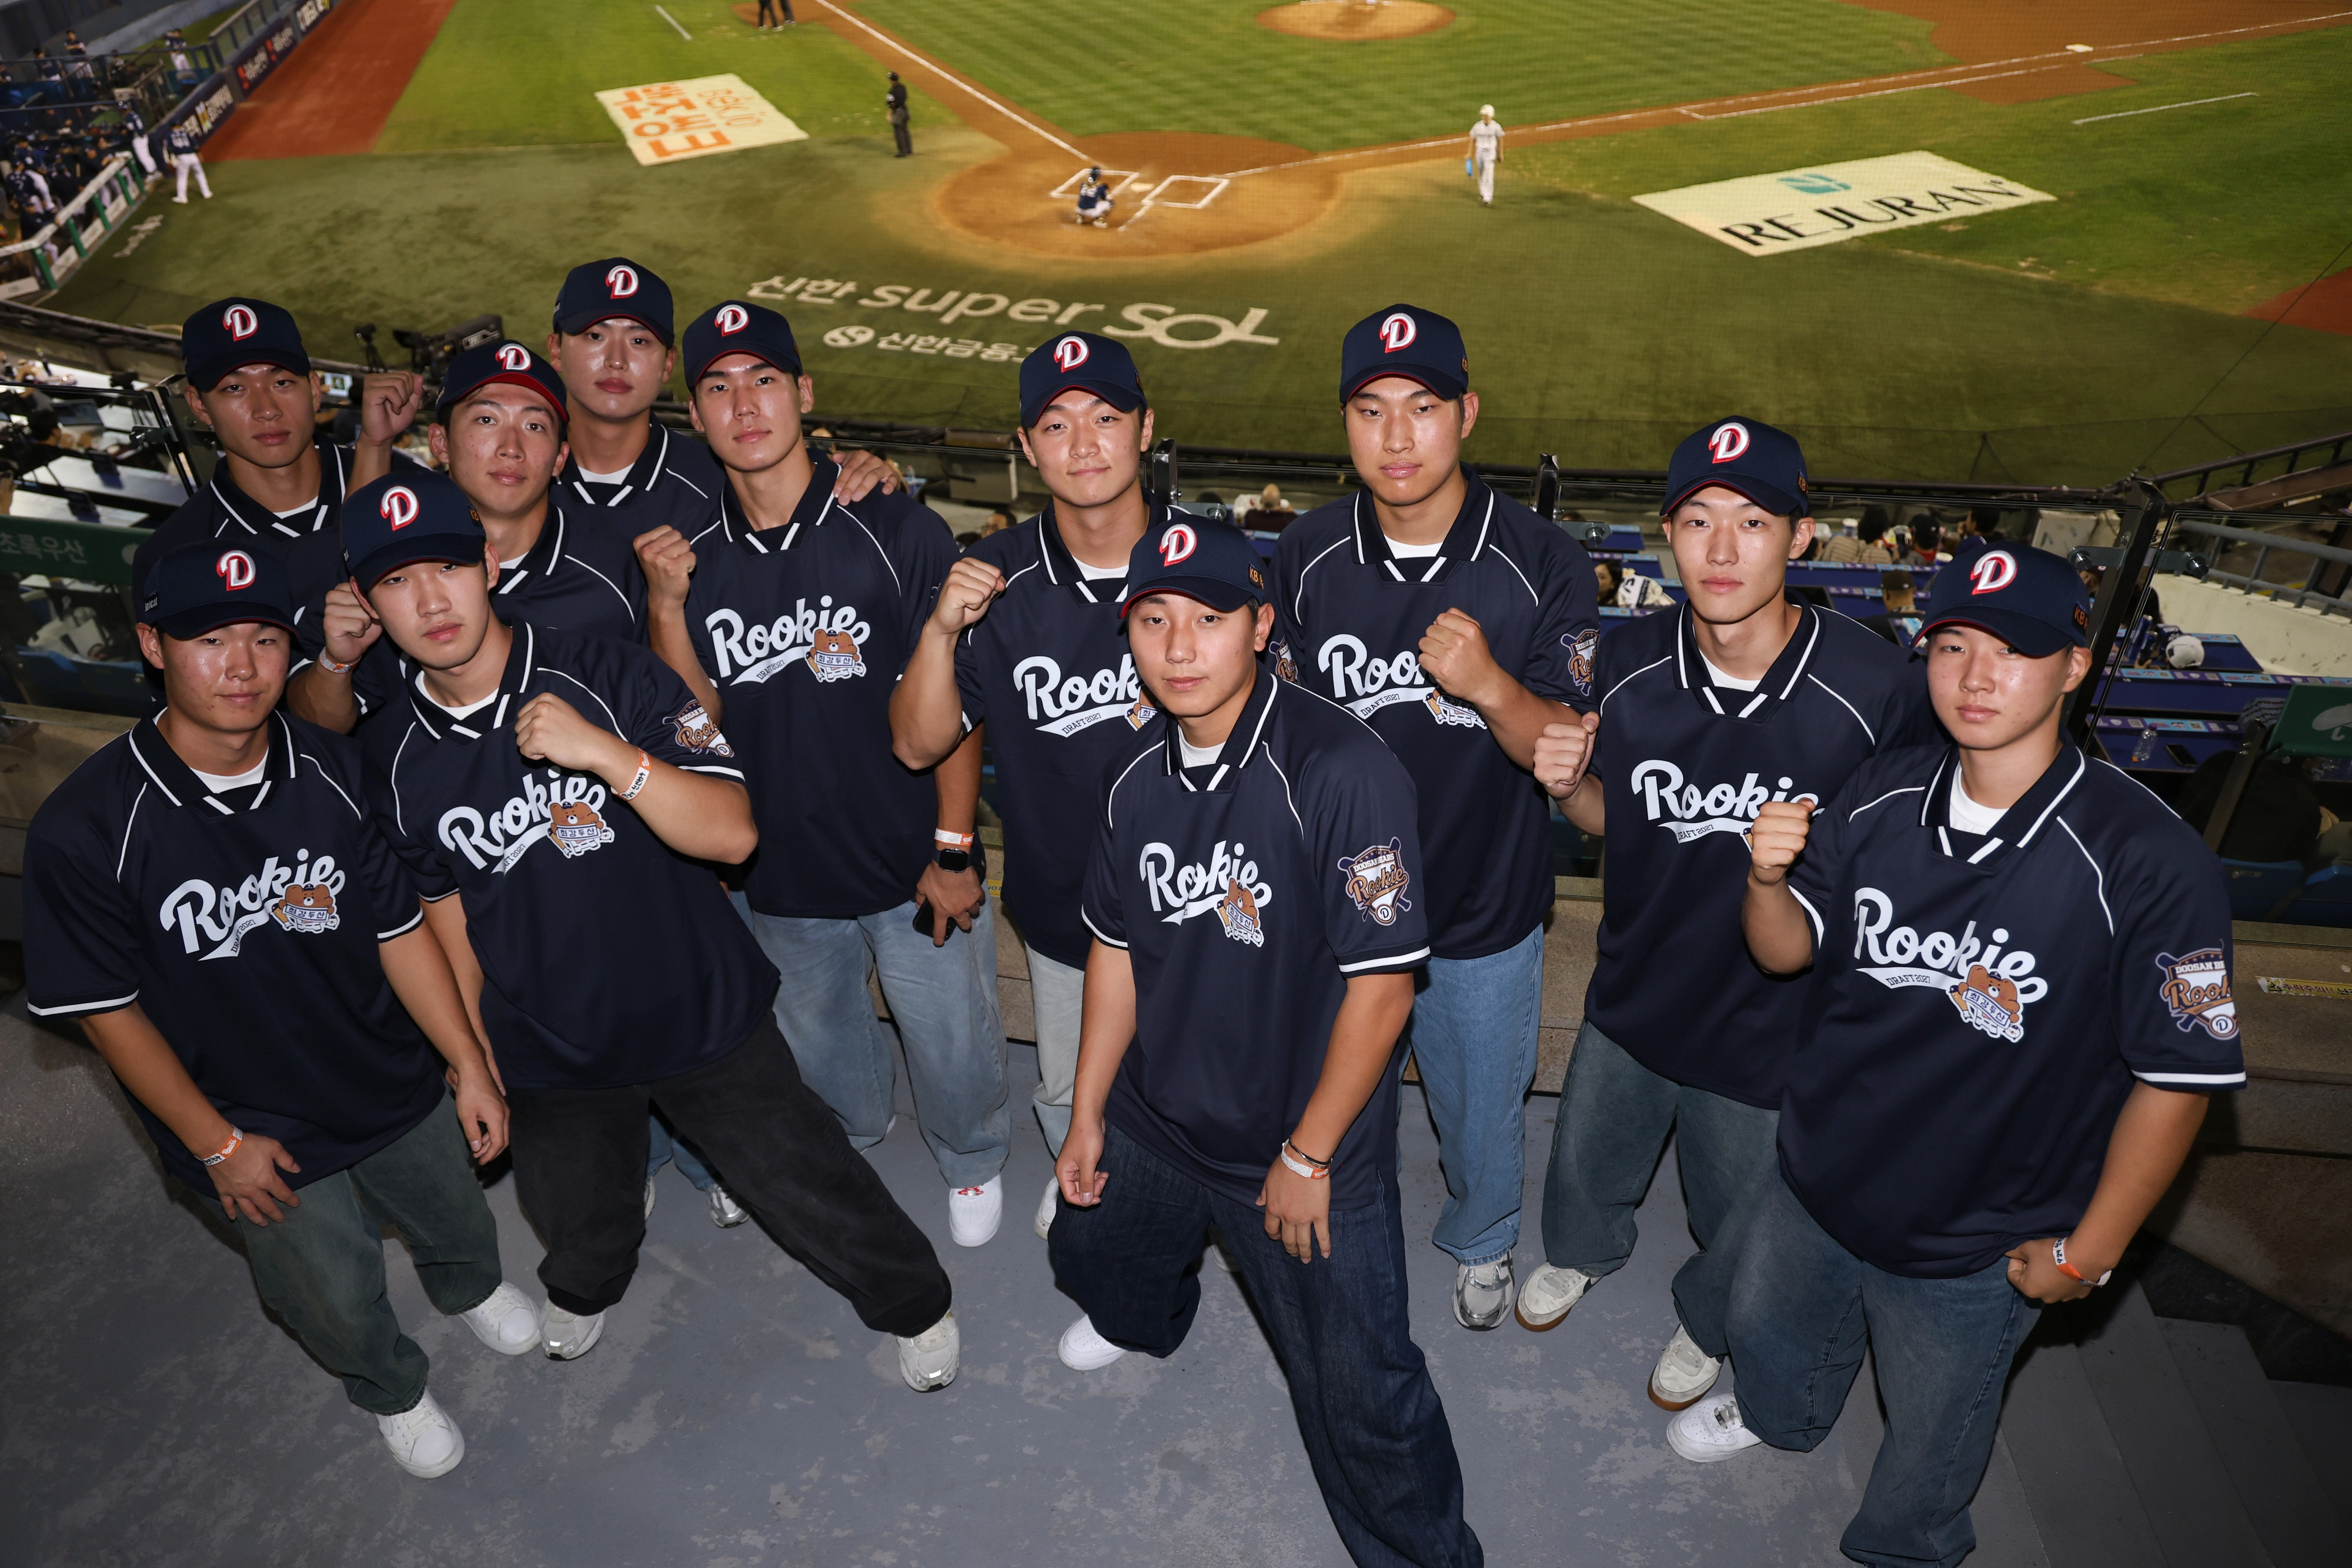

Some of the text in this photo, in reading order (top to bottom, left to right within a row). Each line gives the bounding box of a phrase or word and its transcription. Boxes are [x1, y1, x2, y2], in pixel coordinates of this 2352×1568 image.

[1720, 180, 2023, 246] REJURAN
[606, 265, 639, 299] D
[746, 276, 857, 304] 신한
[222, 303, 259, 342] D
[714, 304, 750, 337] D
[1379, 313, 1417, 353] D
[495, 343, 532, 371] D
[1054, 335, 1089, 373] D
[1708, 422, 1750, 464] D
[379, 484, 420, 531] D
[0, 532, 88, 564] 초록우산
[1160, 523, 1197, 567] D
[216, 549, 256, 591] D
[1970, 550, 2018, 595] D
[705, 595, 870, 678] Rookie
[771, 659, 786, 671] 2027
[817, 654, 851, 665] 최강두산
[1013, 653, 1140, 720] Rook
[1360, 693, 1400, 717] DRAFT 2027
[1061, 713, 1102, 734] DRAFT 2027
[559, 828, 596, 837] 최강두산
[1678, 824, 1714, 841] DRAFT 2027
[511, 844, 526, 858] 2027
[1348, 864, 1404, 903] Rookie
[160, 848, 346, 954] Rookie
[288, 905, 325, 920] 최강두산
[1229, 906, 1253, 929] 최강두산
[230, 919, 257, 954] DRAFT 2027
[1854, 887, 2048, 1004] Rookie
[1886, 974, 1931, 987] DRAFT 2027
[2175, 961, 2213, 974] DOOSAN
[1969, 991, 2007, 1024] 최강두산
[2216, 1018, 2228, 1031] D
